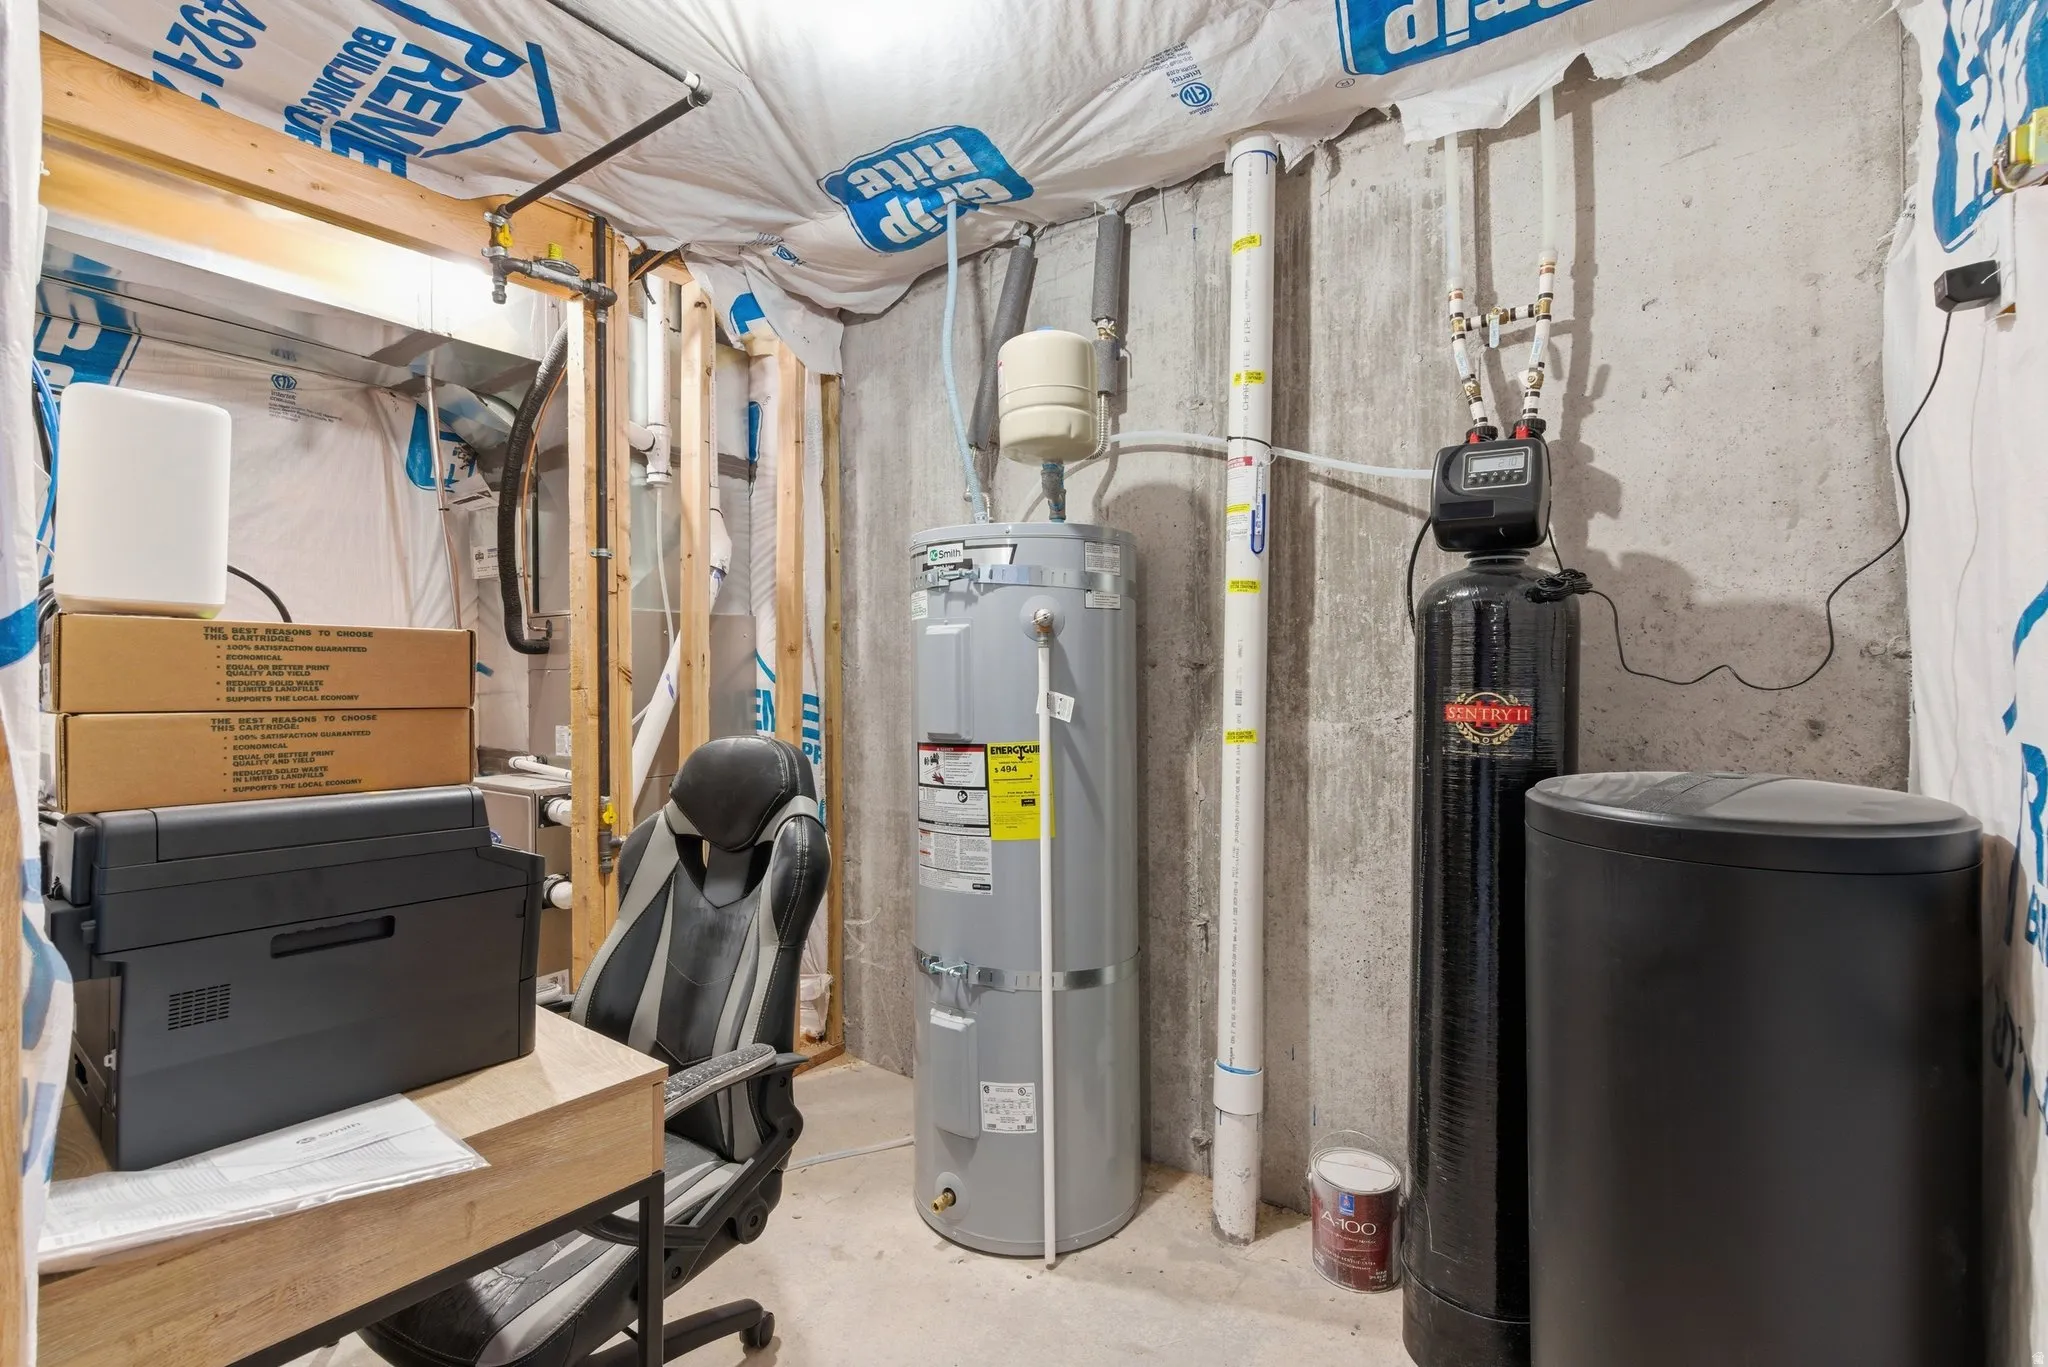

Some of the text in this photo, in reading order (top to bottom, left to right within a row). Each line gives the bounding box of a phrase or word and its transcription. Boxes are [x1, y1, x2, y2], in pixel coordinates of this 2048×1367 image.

[847, 137, 981, 199] Rite
[939, 549, 961, 559] Smith
[265, 628, 311, 636] REASONS
[1448, 706, 1528, 721] SENTRY II
[990, 745, 1040, 756] ENERGYGUI
[233, 769, 272, 777] REDUCED
[1000, 765, 1018, 773] 494
[245, 775, 279, 783] LIMITED
[233, 785, 277, 793] SUPPORTS
[1321, 1210, 1377, 1236] A-100
